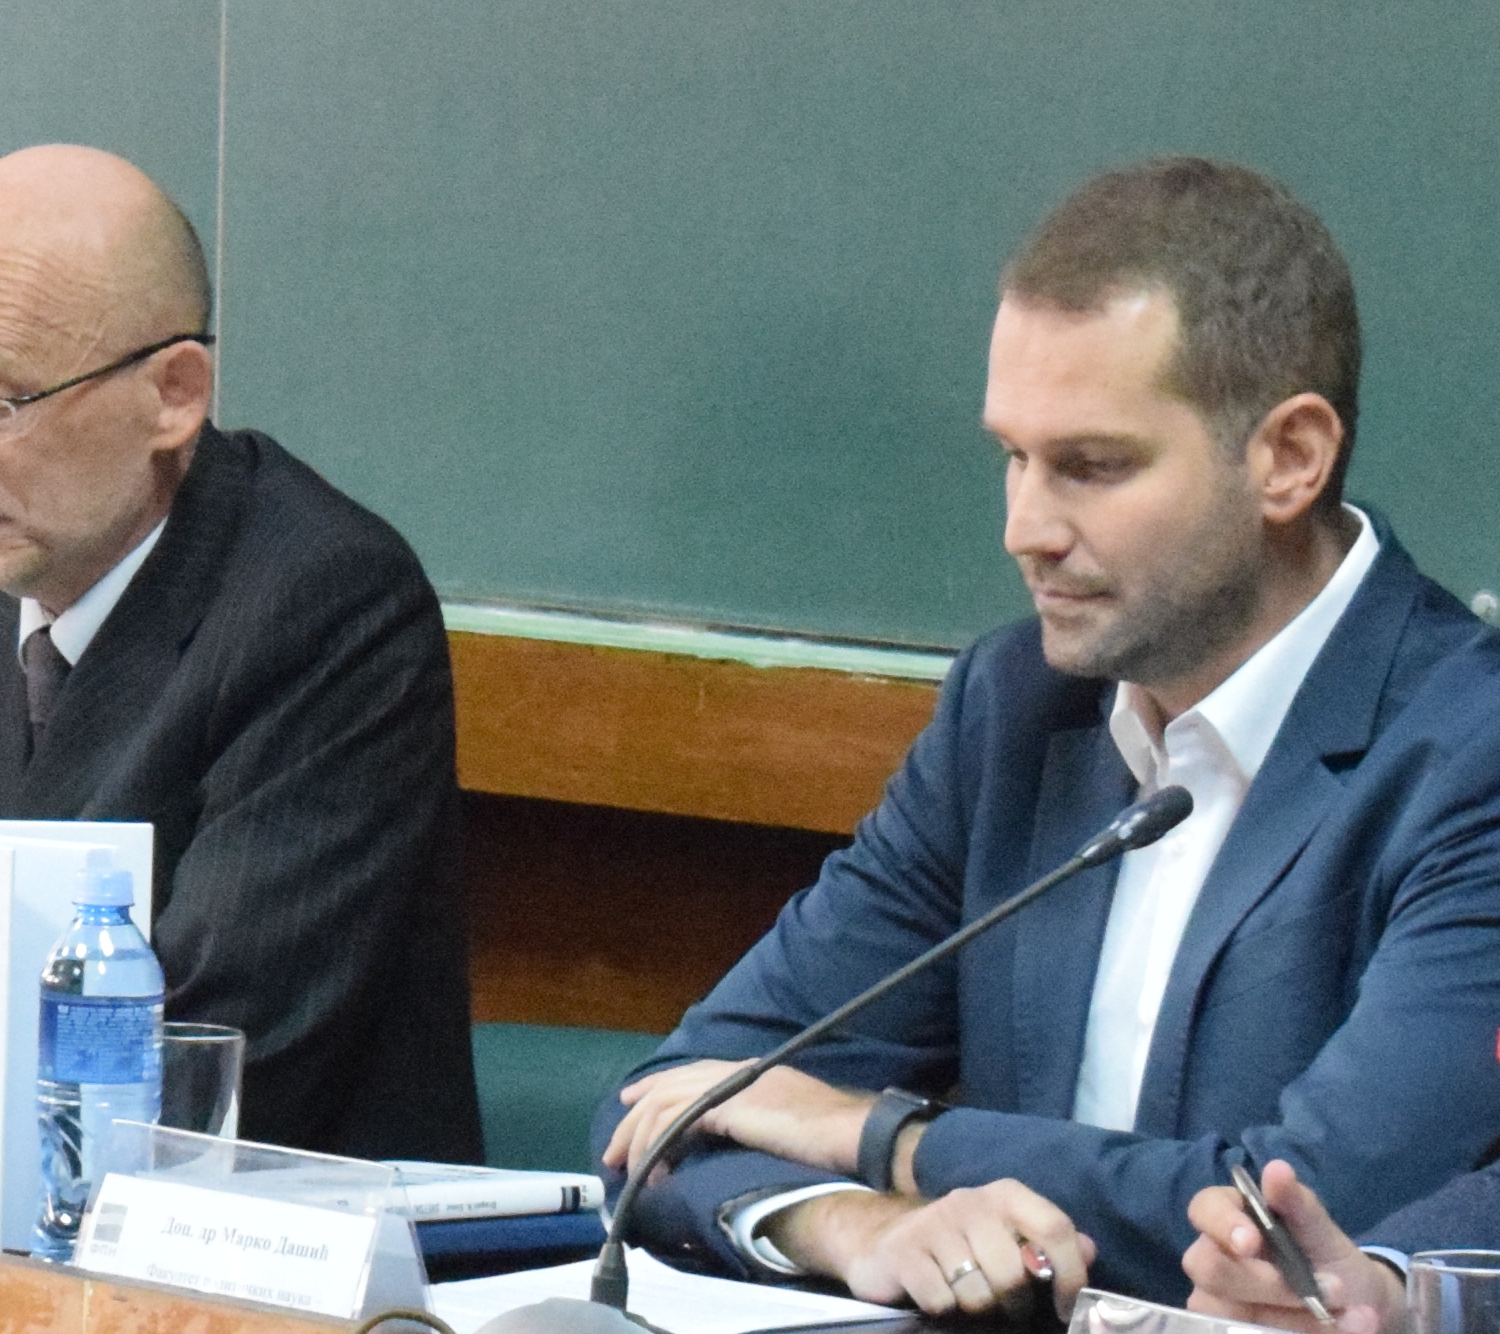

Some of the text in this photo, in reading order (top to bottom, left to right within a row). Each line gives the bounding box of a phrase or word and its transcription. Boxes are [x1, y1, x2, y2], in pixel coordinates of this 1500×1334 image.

[161, 1215, 330, 1262] Доц. др Марко Дашић
